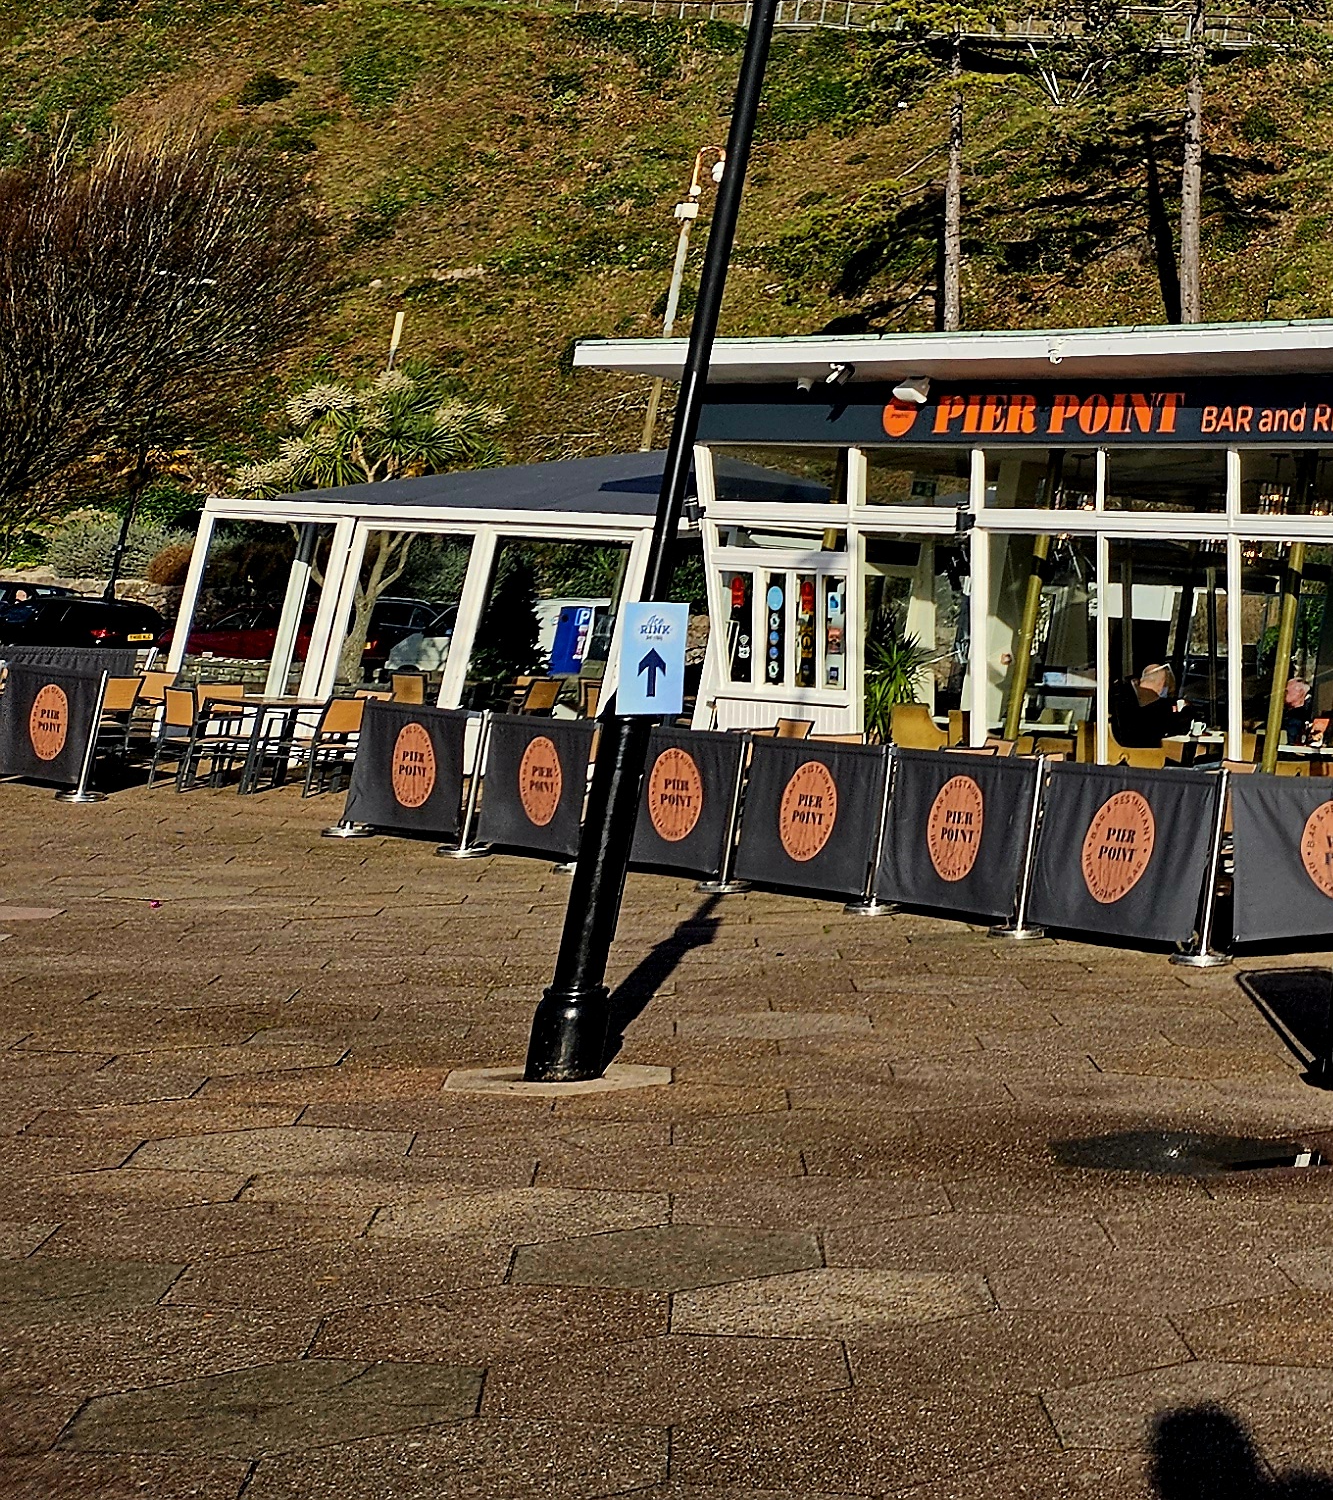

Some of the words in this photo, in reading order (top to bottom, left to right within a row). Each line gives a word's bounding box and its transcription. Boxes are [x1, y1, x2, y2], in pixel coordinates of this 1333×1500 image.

[932, 393, 1038, 434] PIER
[1046, 392, 1185, 434] POINT
[1200, 405, 1253, 433] BAR
[1258, 402, 1307, 432] and
[640, 625, 671, 634] RINK
[402, 751, 425, 763] PIER
[399, 765, 427, 777] POINT
[531, 766, 553, 778] PIER
[529, 780, 554, 793] POINT
[664, 778, 689, 791] PIER
[660, 794, 692, 808] POINT
[798, 793, 823, 808] PIER
[792, 810, 825, 825] POINT
[945, 810, 973, 826] PIER
[940, 828, 975, 844] POINT
[1106, 827, 1136, 844] PIER
[1098, 846, 1138, 863] POINT
